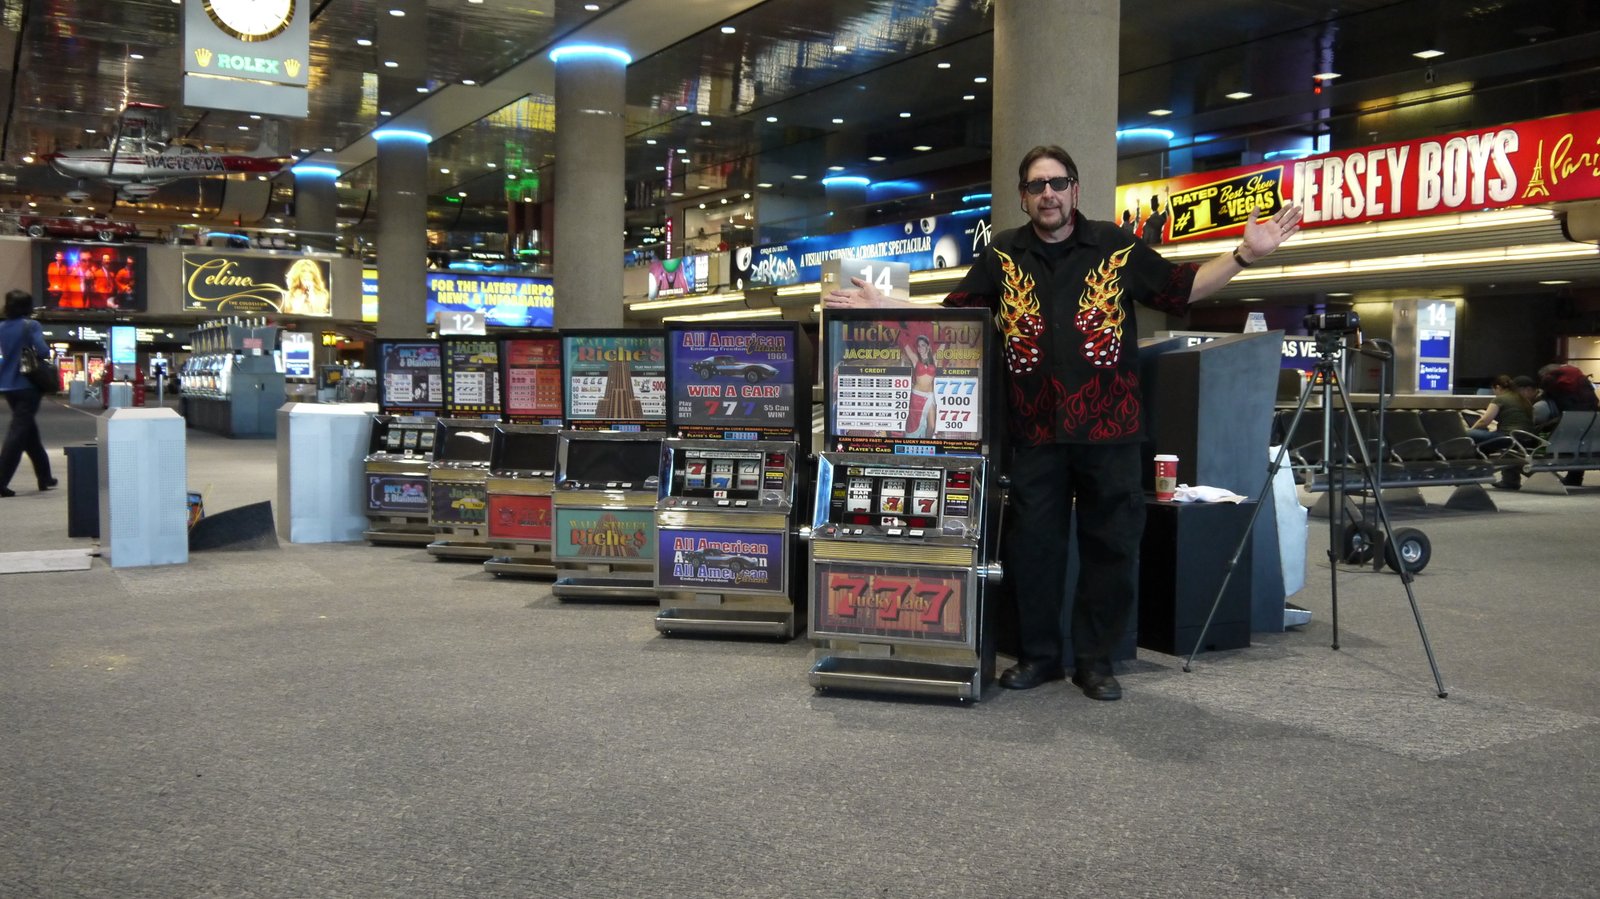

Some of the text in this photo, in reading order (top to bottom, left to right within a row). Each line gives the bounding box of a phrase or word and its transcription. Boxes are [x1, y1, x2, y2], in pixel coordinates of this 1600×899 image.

[217, 53, 279, 74] ROLEX
[1550, 134, 1600, 184] Pari
[1286, 129, 1518, 223] JERSEY BOYS
[1173, 187, 1218, 207] RATED
[1220, 175, 1276, 203] Best Show
[1227, 191, 1274, 218] VEGAS
[1175, 199, 1217, 232] #1
[800, 254, 805, 268] A
[856, 241, 888, 259] ACROBATIC
[888, 236, 931, 255] SPECTACULAR
[750, 254, 799, 284] ZARKANA
[188, 259, 254, 301] Celine
[431, 279, 554, 297] FOR THE LATEST AIRPO
[860, 265, 893, 296] 14
[437, 293, 469, 305] NEWS
[452, 314, 475, 332] 12
[1427, 303, 1447, 326] 14
[290, 334, 305, 343] 10
[682, 332, 705, 347] All
[709, 332, 786, 348] American
[842, 322, 980, 347] Lucky Lady
[936, 348, 980, 360] BONUS
[1281, 341, 1299, 357] AS
[687, 385, 780, 398] WIN A CAR!
[894, 378, 909, 389] 80
[895, 391, 908, 399] 50
[941, 396, 970, 406] 1000
[775, 404, 789, 412] Can
[895, 401, 908, 410] 20
[895, 411, 907, 420] 10
[897, 421, 903, 430] 1
[945, 421, 963, 429] 300
[603, 520, 649, 530] STREET
[674, 537, 769, 555] All American
[673, 563, 694, 576] All
[848, 590, 932, 614] Lucky Lady
